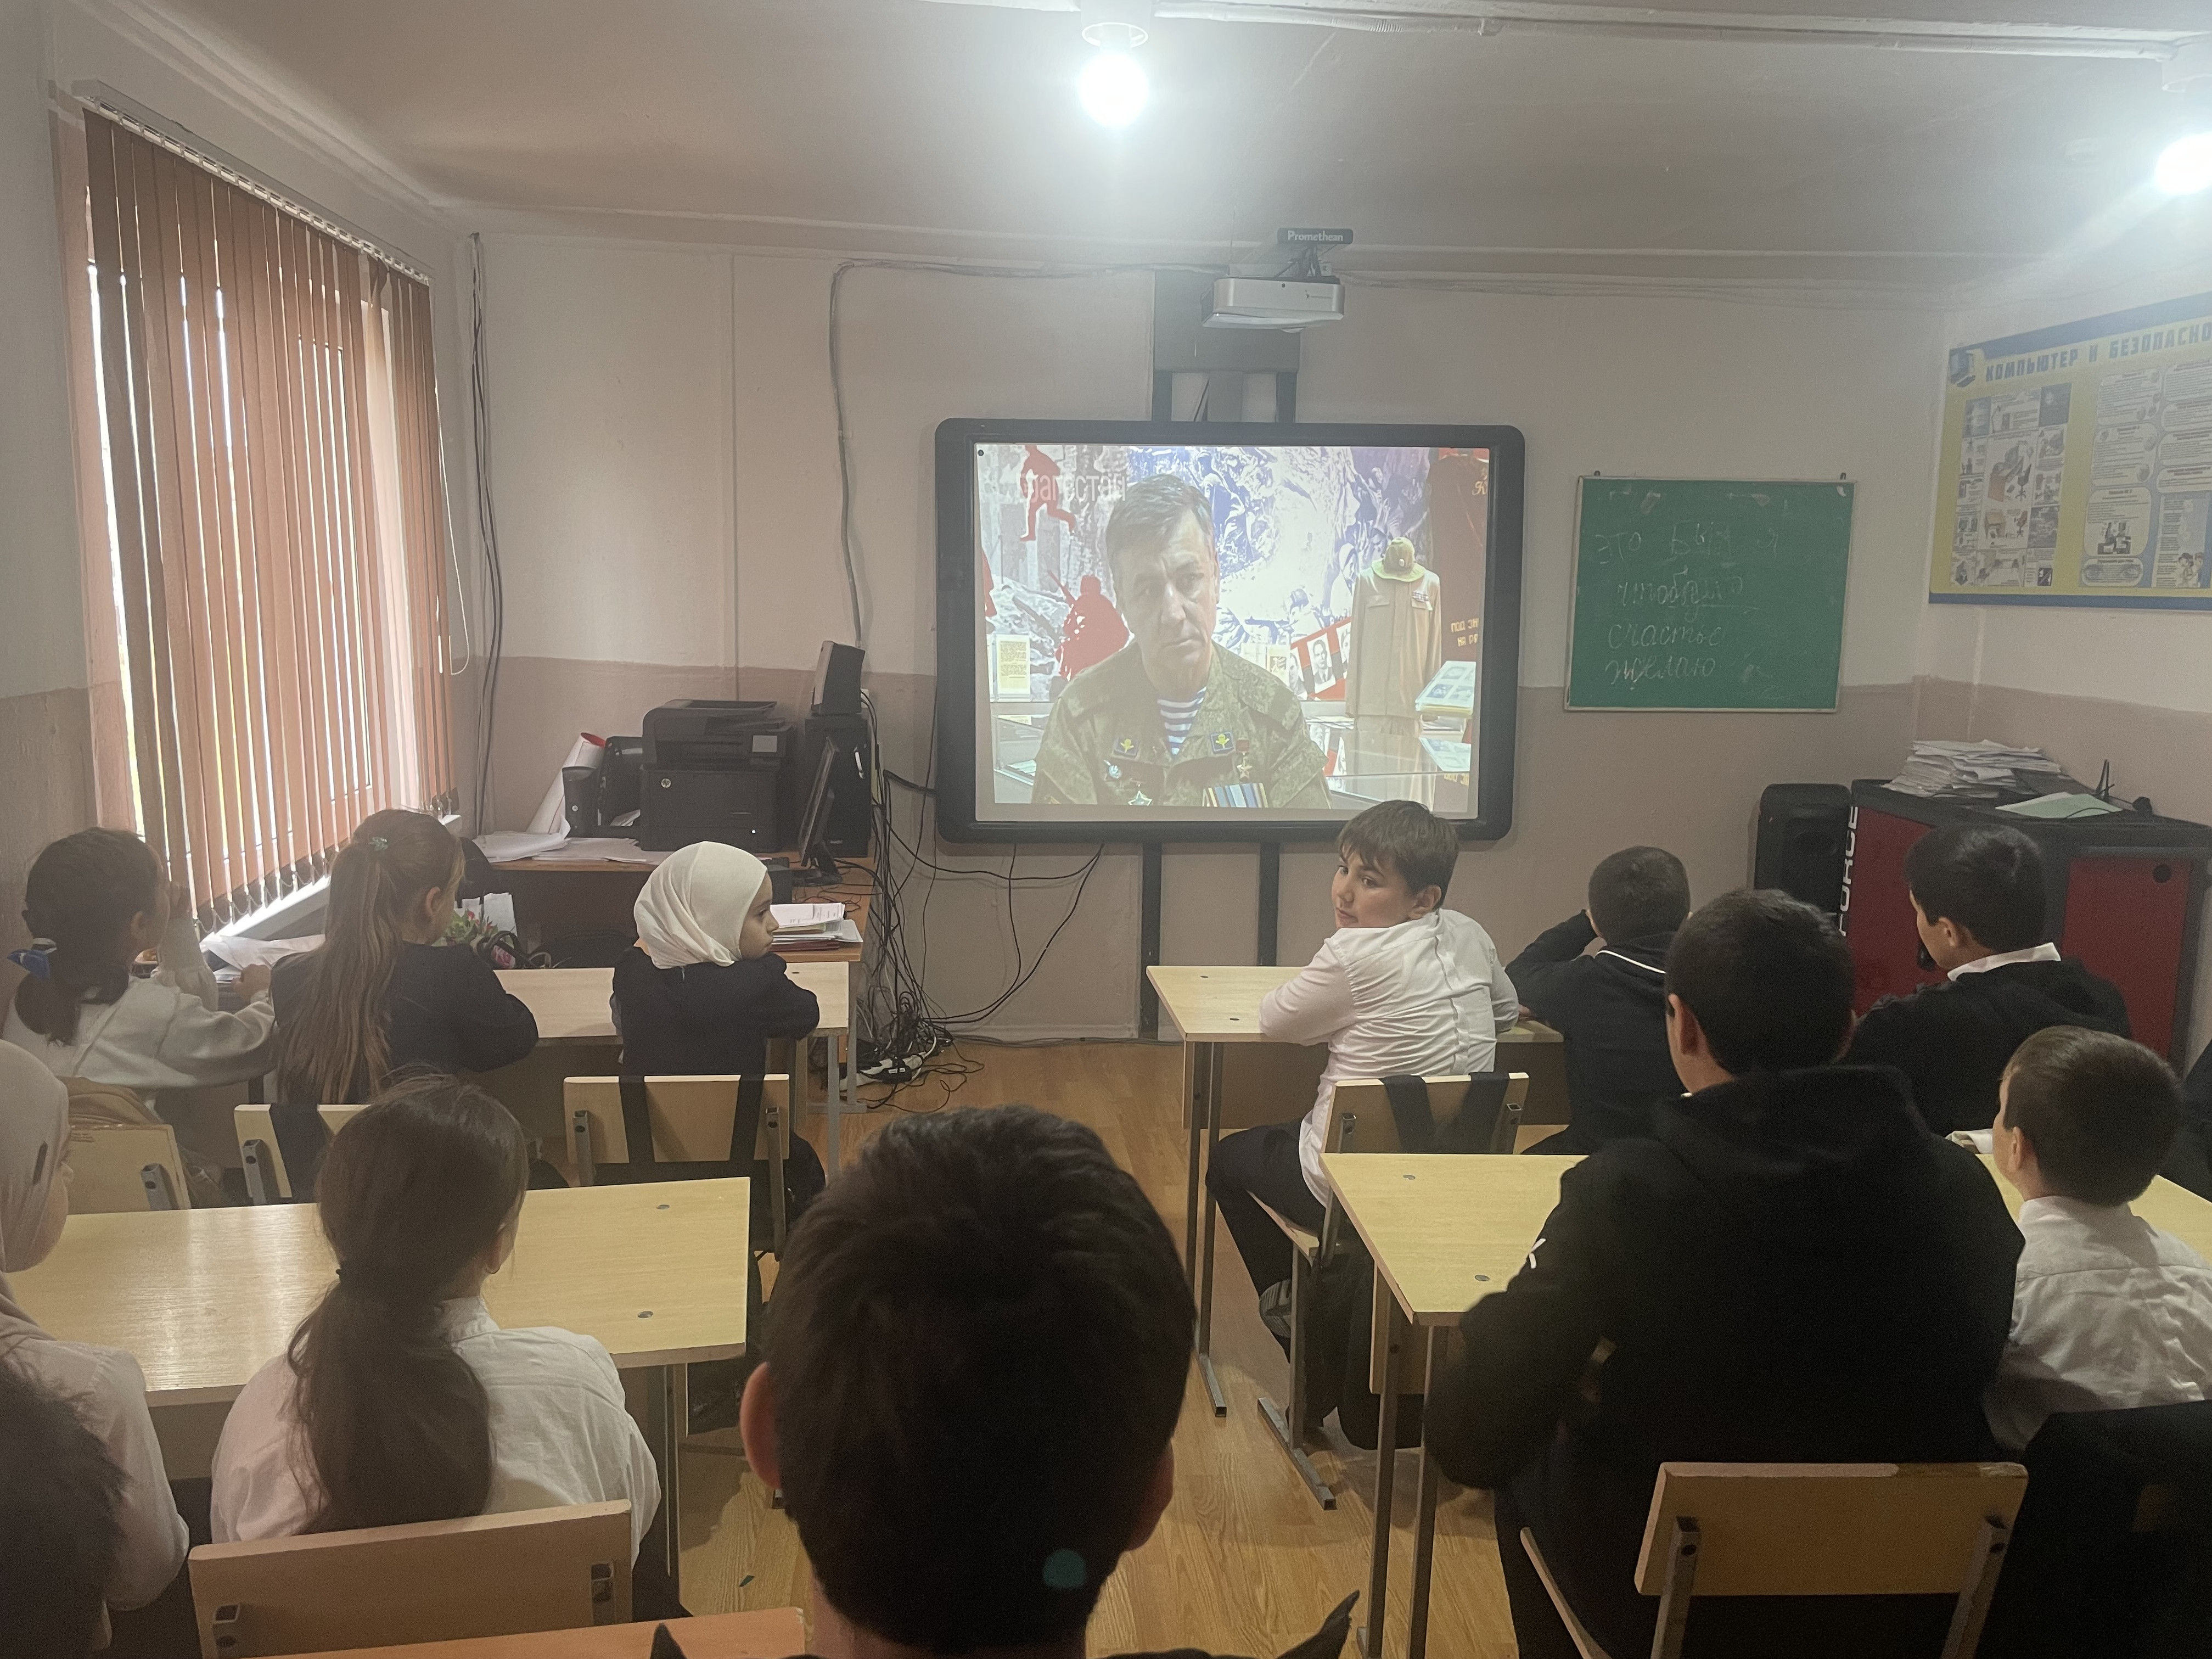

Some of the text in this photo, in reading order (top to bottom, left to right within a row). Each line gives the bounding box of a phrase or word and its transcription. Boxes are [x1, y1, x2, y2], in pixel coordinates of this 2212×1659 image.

[1287, 230, 1344, 241] Promethean
[1985, 348, 2079, 382] КОМПЬЮТЕР
[2089, 344, 2099, 363] И
